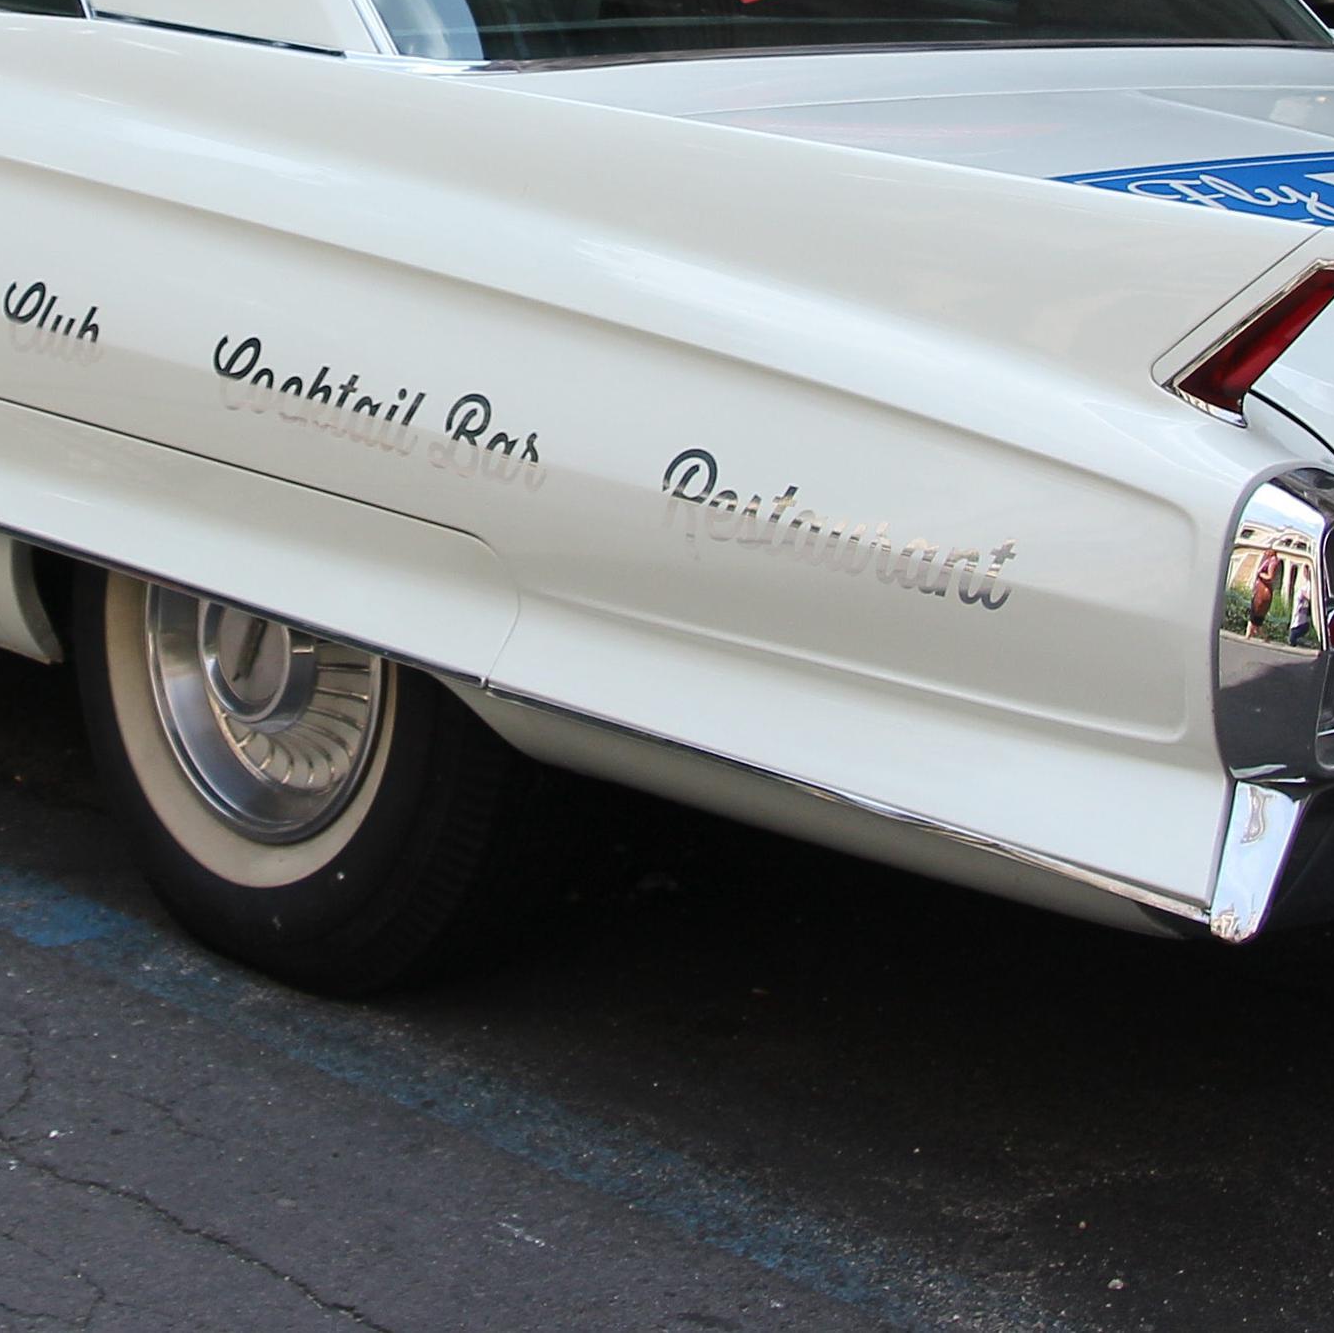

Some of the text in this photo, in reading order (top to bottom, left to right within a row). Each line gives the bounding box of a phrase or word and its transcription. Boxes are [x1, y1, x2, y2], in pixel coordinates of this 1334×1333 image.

[3, 282, 104, 365] Club
[213, 335, 547, 491] Cocktail Bar
[662, 448, 1018, 610] Restaurant
